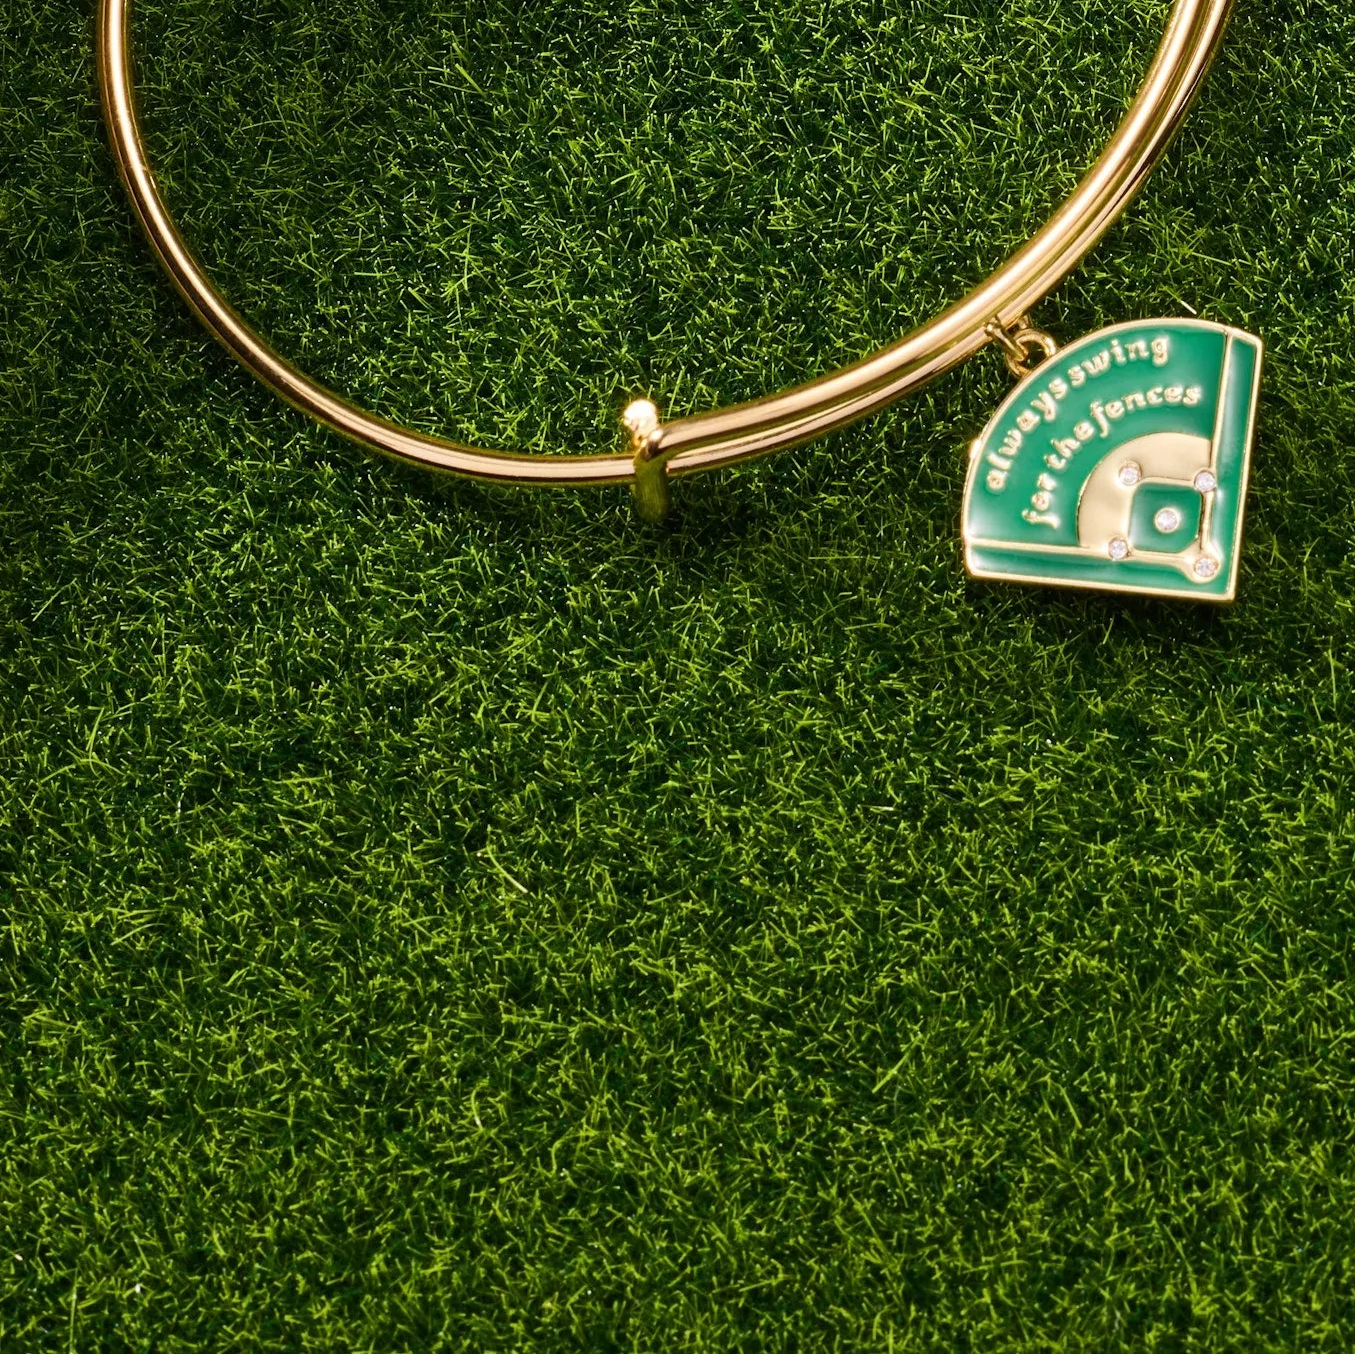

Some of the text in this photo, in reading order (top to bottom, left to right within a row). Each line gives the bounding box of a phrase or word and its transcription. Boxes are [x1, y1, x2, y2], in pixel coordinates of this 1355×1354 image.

[986, 336, 1170, 493] always swing
[1022, 384, 1202, 530] for the fences
